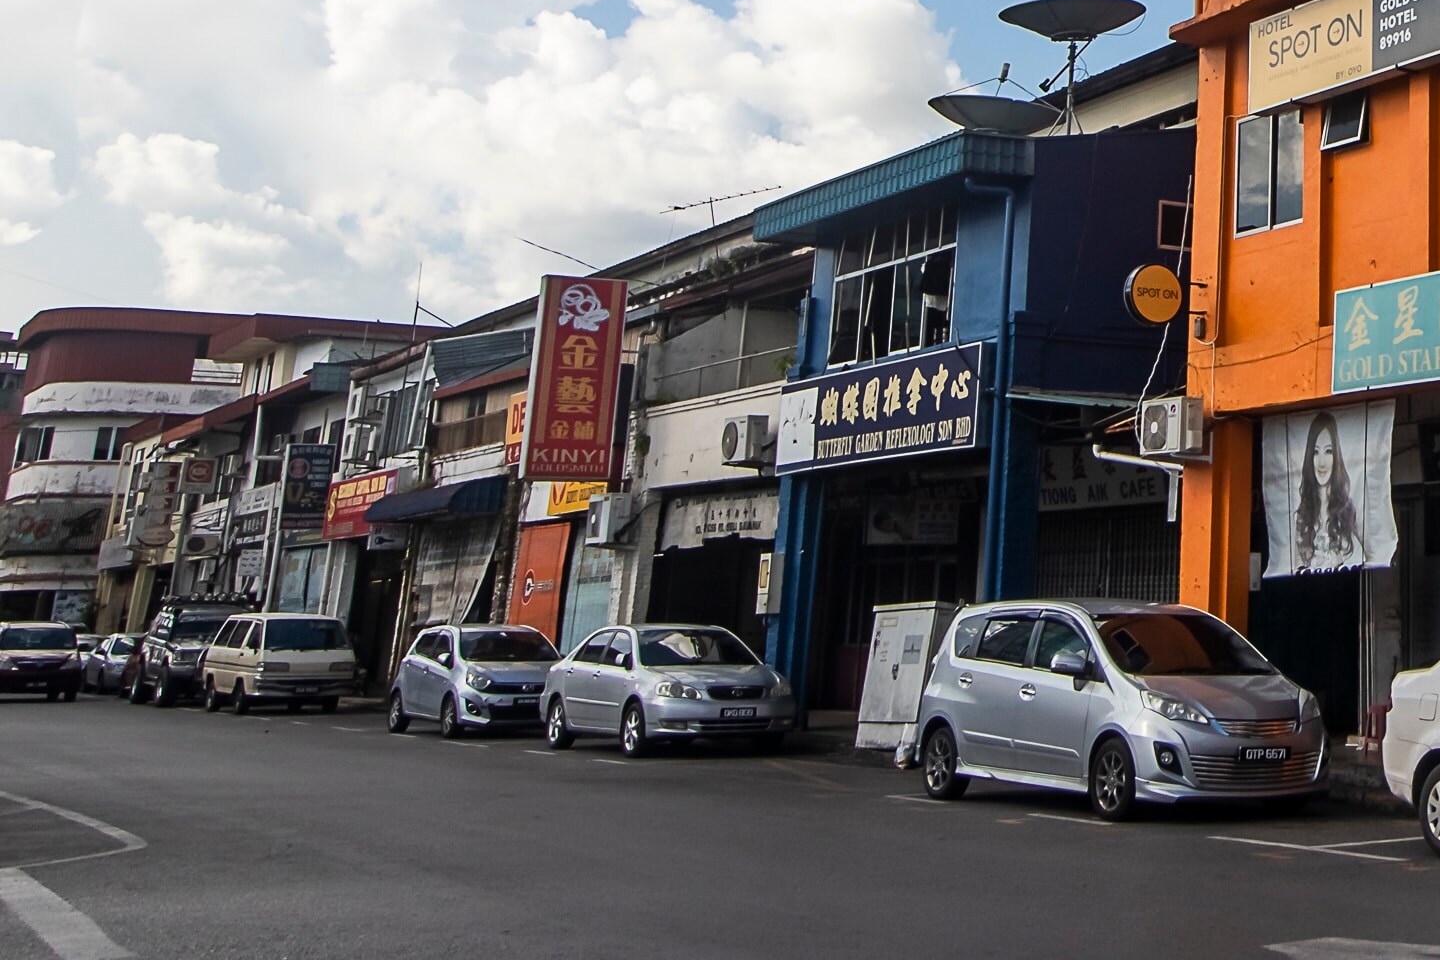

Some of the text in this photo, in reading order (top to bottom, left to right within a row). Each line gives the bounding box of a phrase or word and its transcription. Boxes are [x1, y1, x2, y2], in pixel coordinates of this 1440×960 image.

[1257, 14, 1294, 39] HOTEL
[1379, 7, 1418, 33] HOTEL
[1268, 9, 1363, 68] SPOT ON
[1379, 30, 1412, 50] 89916
[1336, 64, 1363, 80] BY OYO
[1136, 286, 1179, 300] SPOT ON
[1338, 355, 1394, 384] GOLD
[816, 415, 972, 460] BUTTERFLY GARDEN REFLEXOLOGY SDN BHD
[531, 447, 606, 464] KINYI
[530, 462, 605, 474] GOLDSMITH
[1040, 477, 1156, 505] TIONG AIK CAFE
[1265, 748, 1287, 760] 6671
